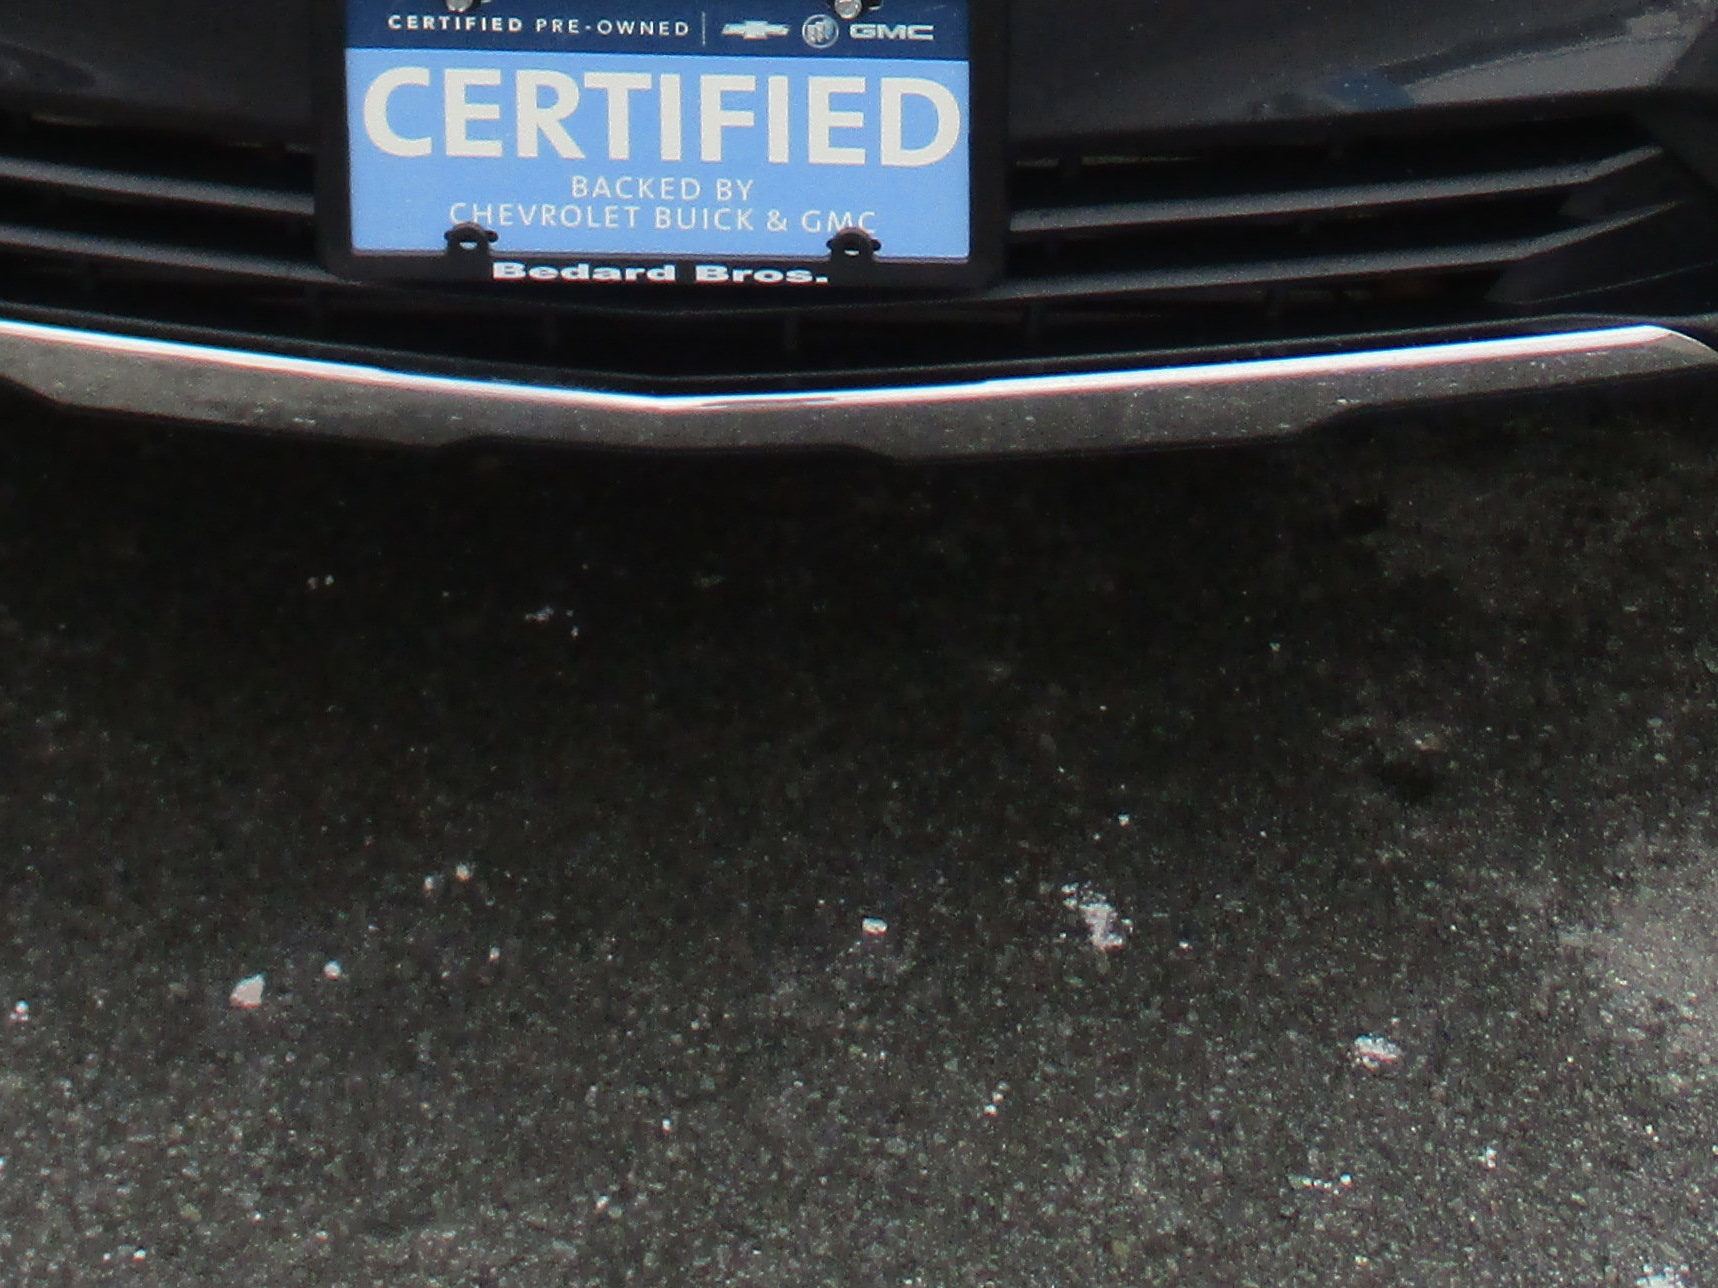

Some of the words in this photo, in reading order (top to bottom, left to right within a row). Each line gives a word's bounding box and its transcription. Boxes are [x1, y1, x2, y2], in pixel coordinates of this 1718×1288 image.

[388, 15, 523, 32] CERTIFIED
[535, 18, 690, 36] PRE-OWNED
[849, 24, 934, 40] GMC
[363, 66, 961, 167] CERTIFIED
[571, 175, 701, 201] BACKED
[716, 178, 754, 202] BY
[449, 202, 640, 228] CHEVROLET
[655, 206, 754, 232] BUICK
[766, 210, 788, 232] &
[801, 210, 876, 234] GMC
[493, 262, 676, 282] Bedard
[695, 264, 829, 285] Bros.
